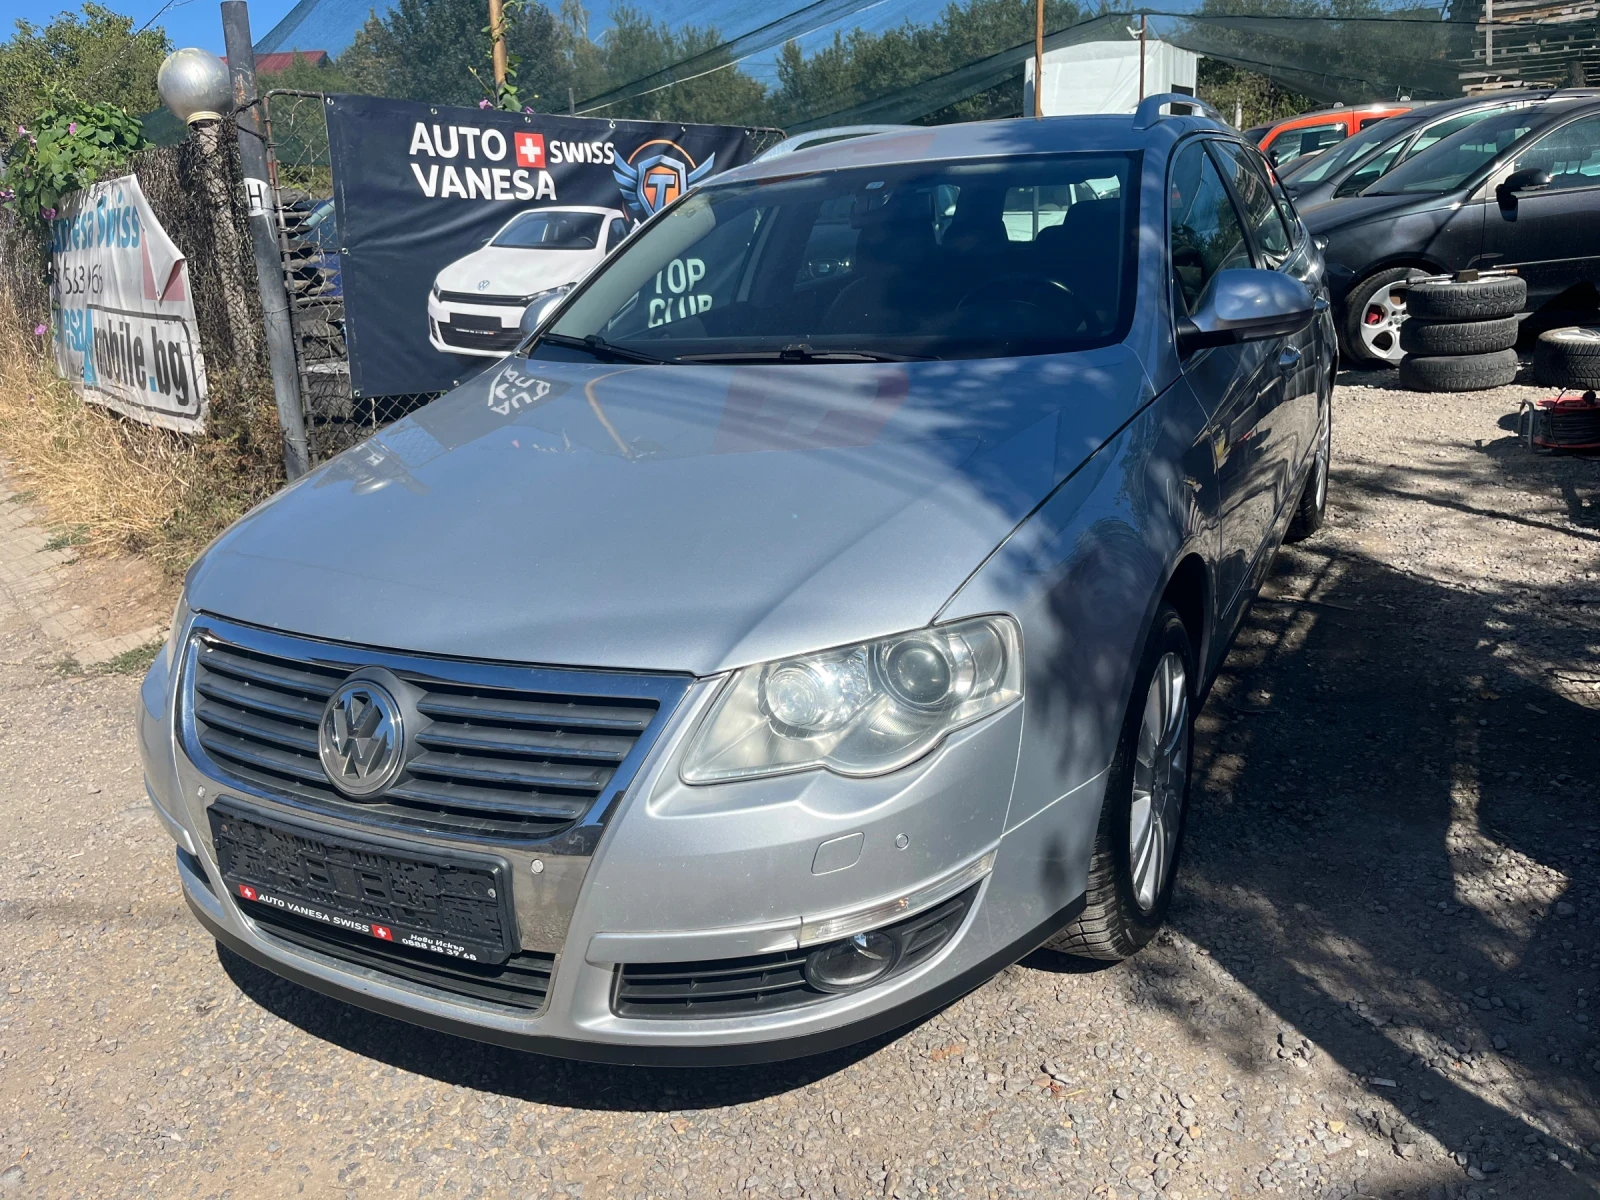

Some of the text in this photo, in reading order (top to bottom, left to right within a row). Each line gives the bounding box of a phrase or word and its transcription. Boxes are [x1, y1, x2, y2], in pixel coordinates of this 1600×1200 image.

[409, 122, 615, 165] AUTO SWISS
[410, 163, 557, 201] VANESA
[258, 893, 370, 932] AUTO VANESA SWISS
